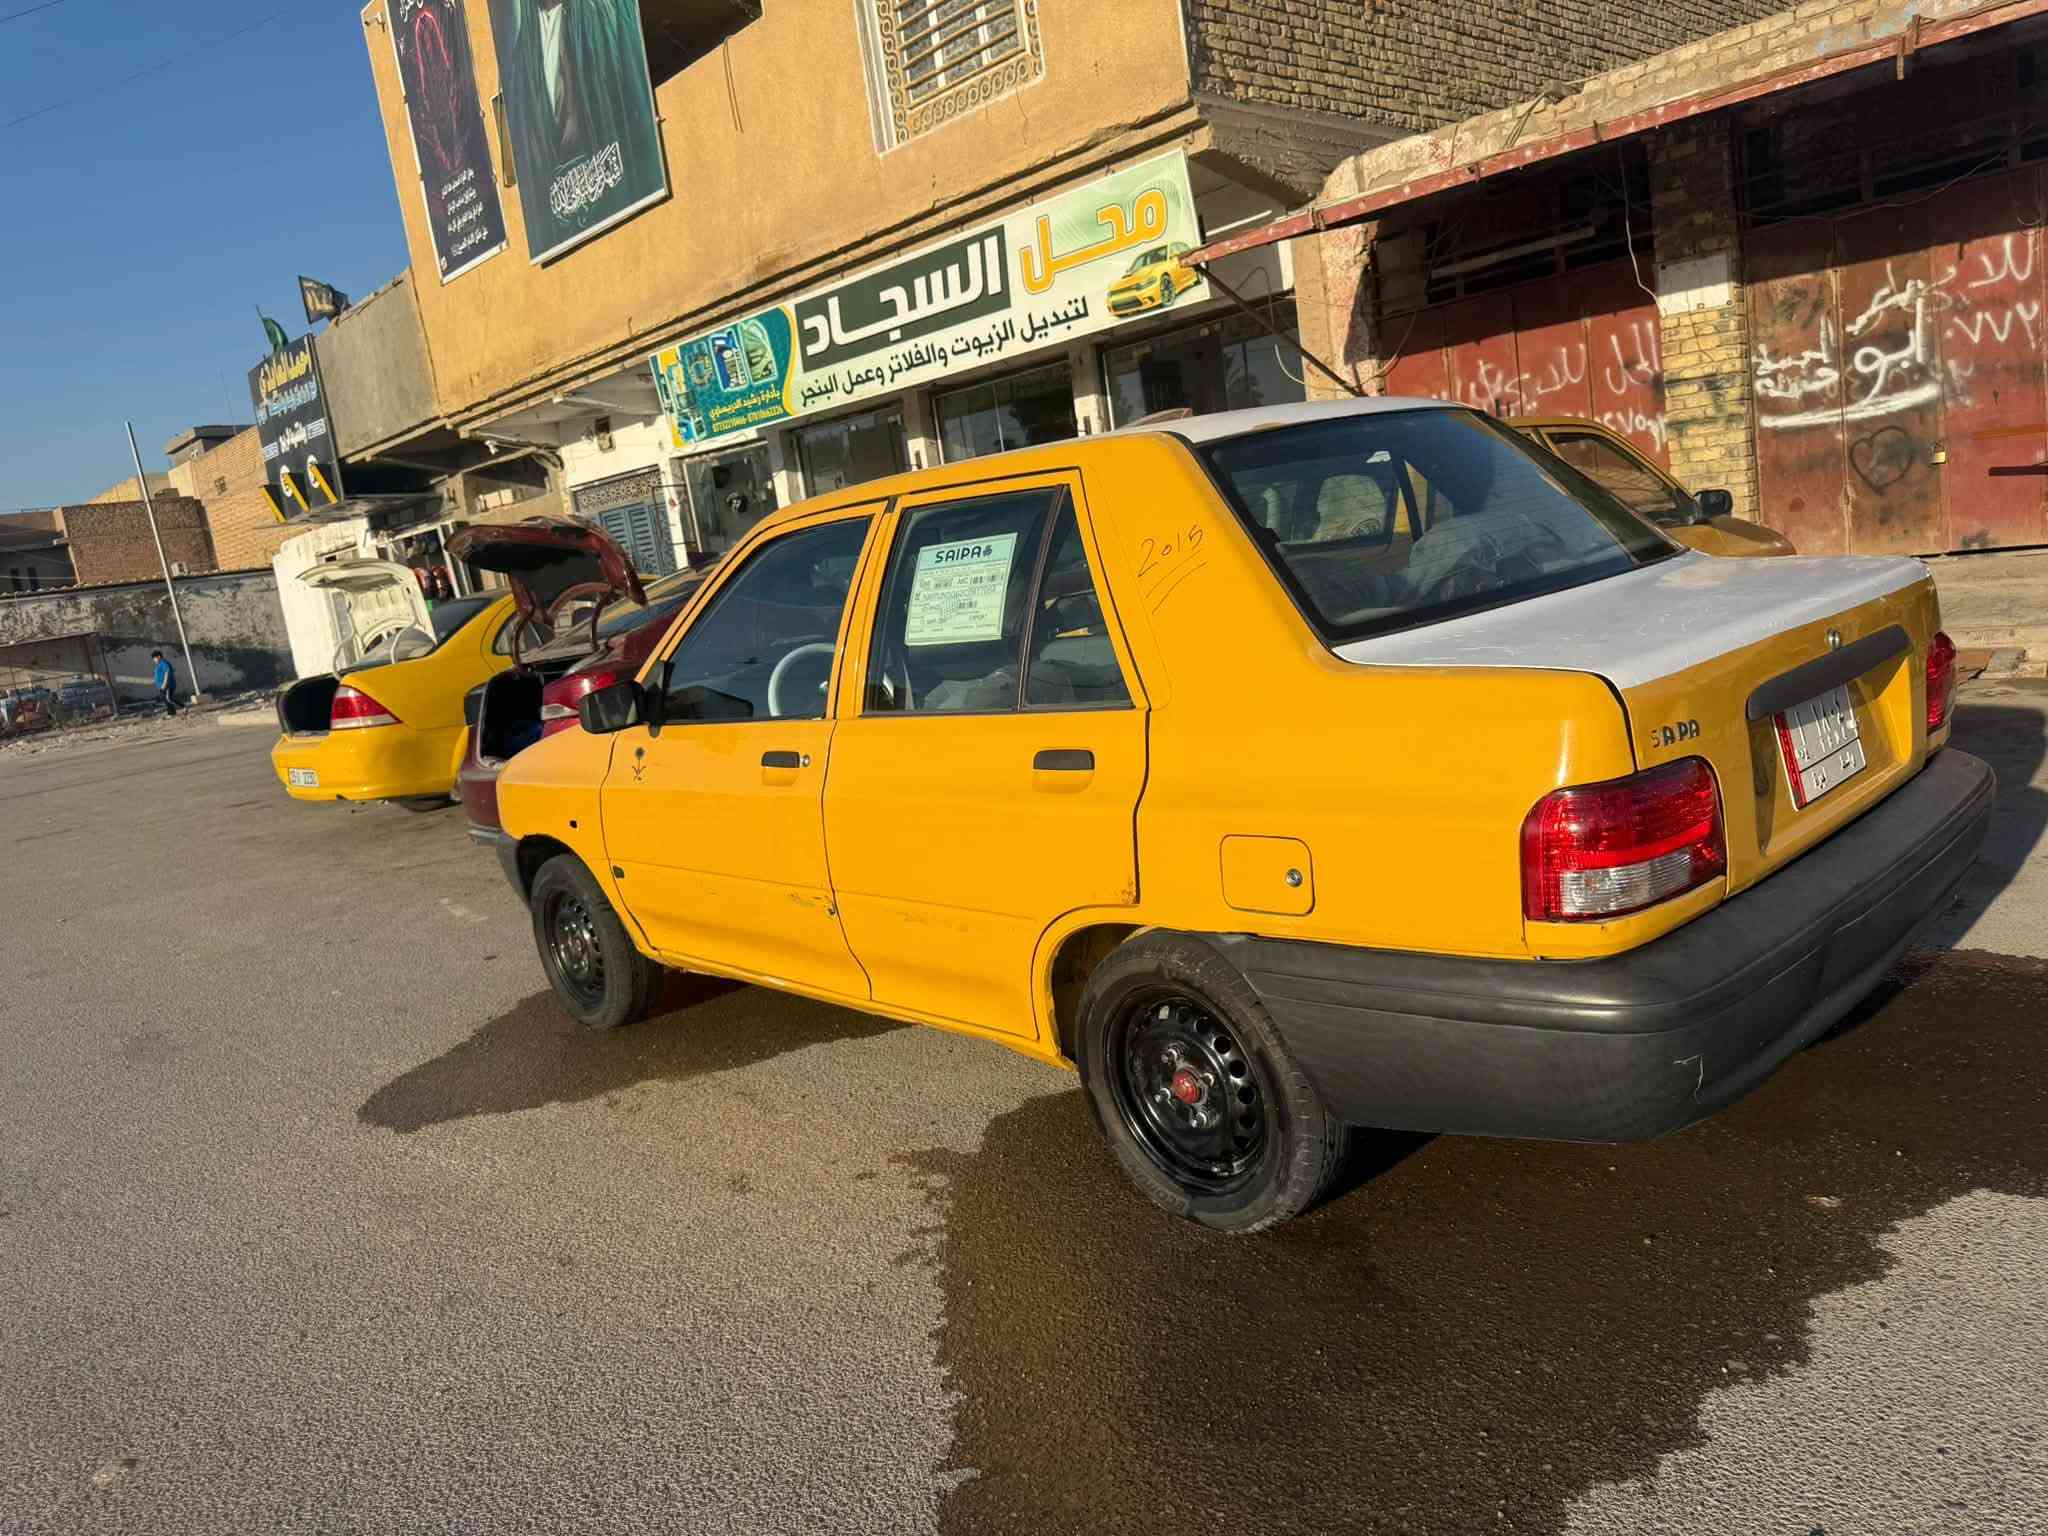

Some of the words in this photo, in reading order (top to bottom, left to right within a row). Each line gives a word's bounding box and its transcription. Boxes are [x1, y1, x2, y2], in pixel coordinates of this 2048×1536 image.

[1018, 188, 1169, 295] محل
[804, 235, 1002, 356] السجاد
[951, 318, 1015, 357] الزيوت
[1020, 296, 1089, 343] لتبديل
[842, 366, 885, 394] وعمل
[889, 342, 948, 383] والفلاتر
[800, 373, 839, 407] البنجر
[935, 545, 982, 564] SAIPA
[1137, 525, 1203, 578] 2015
